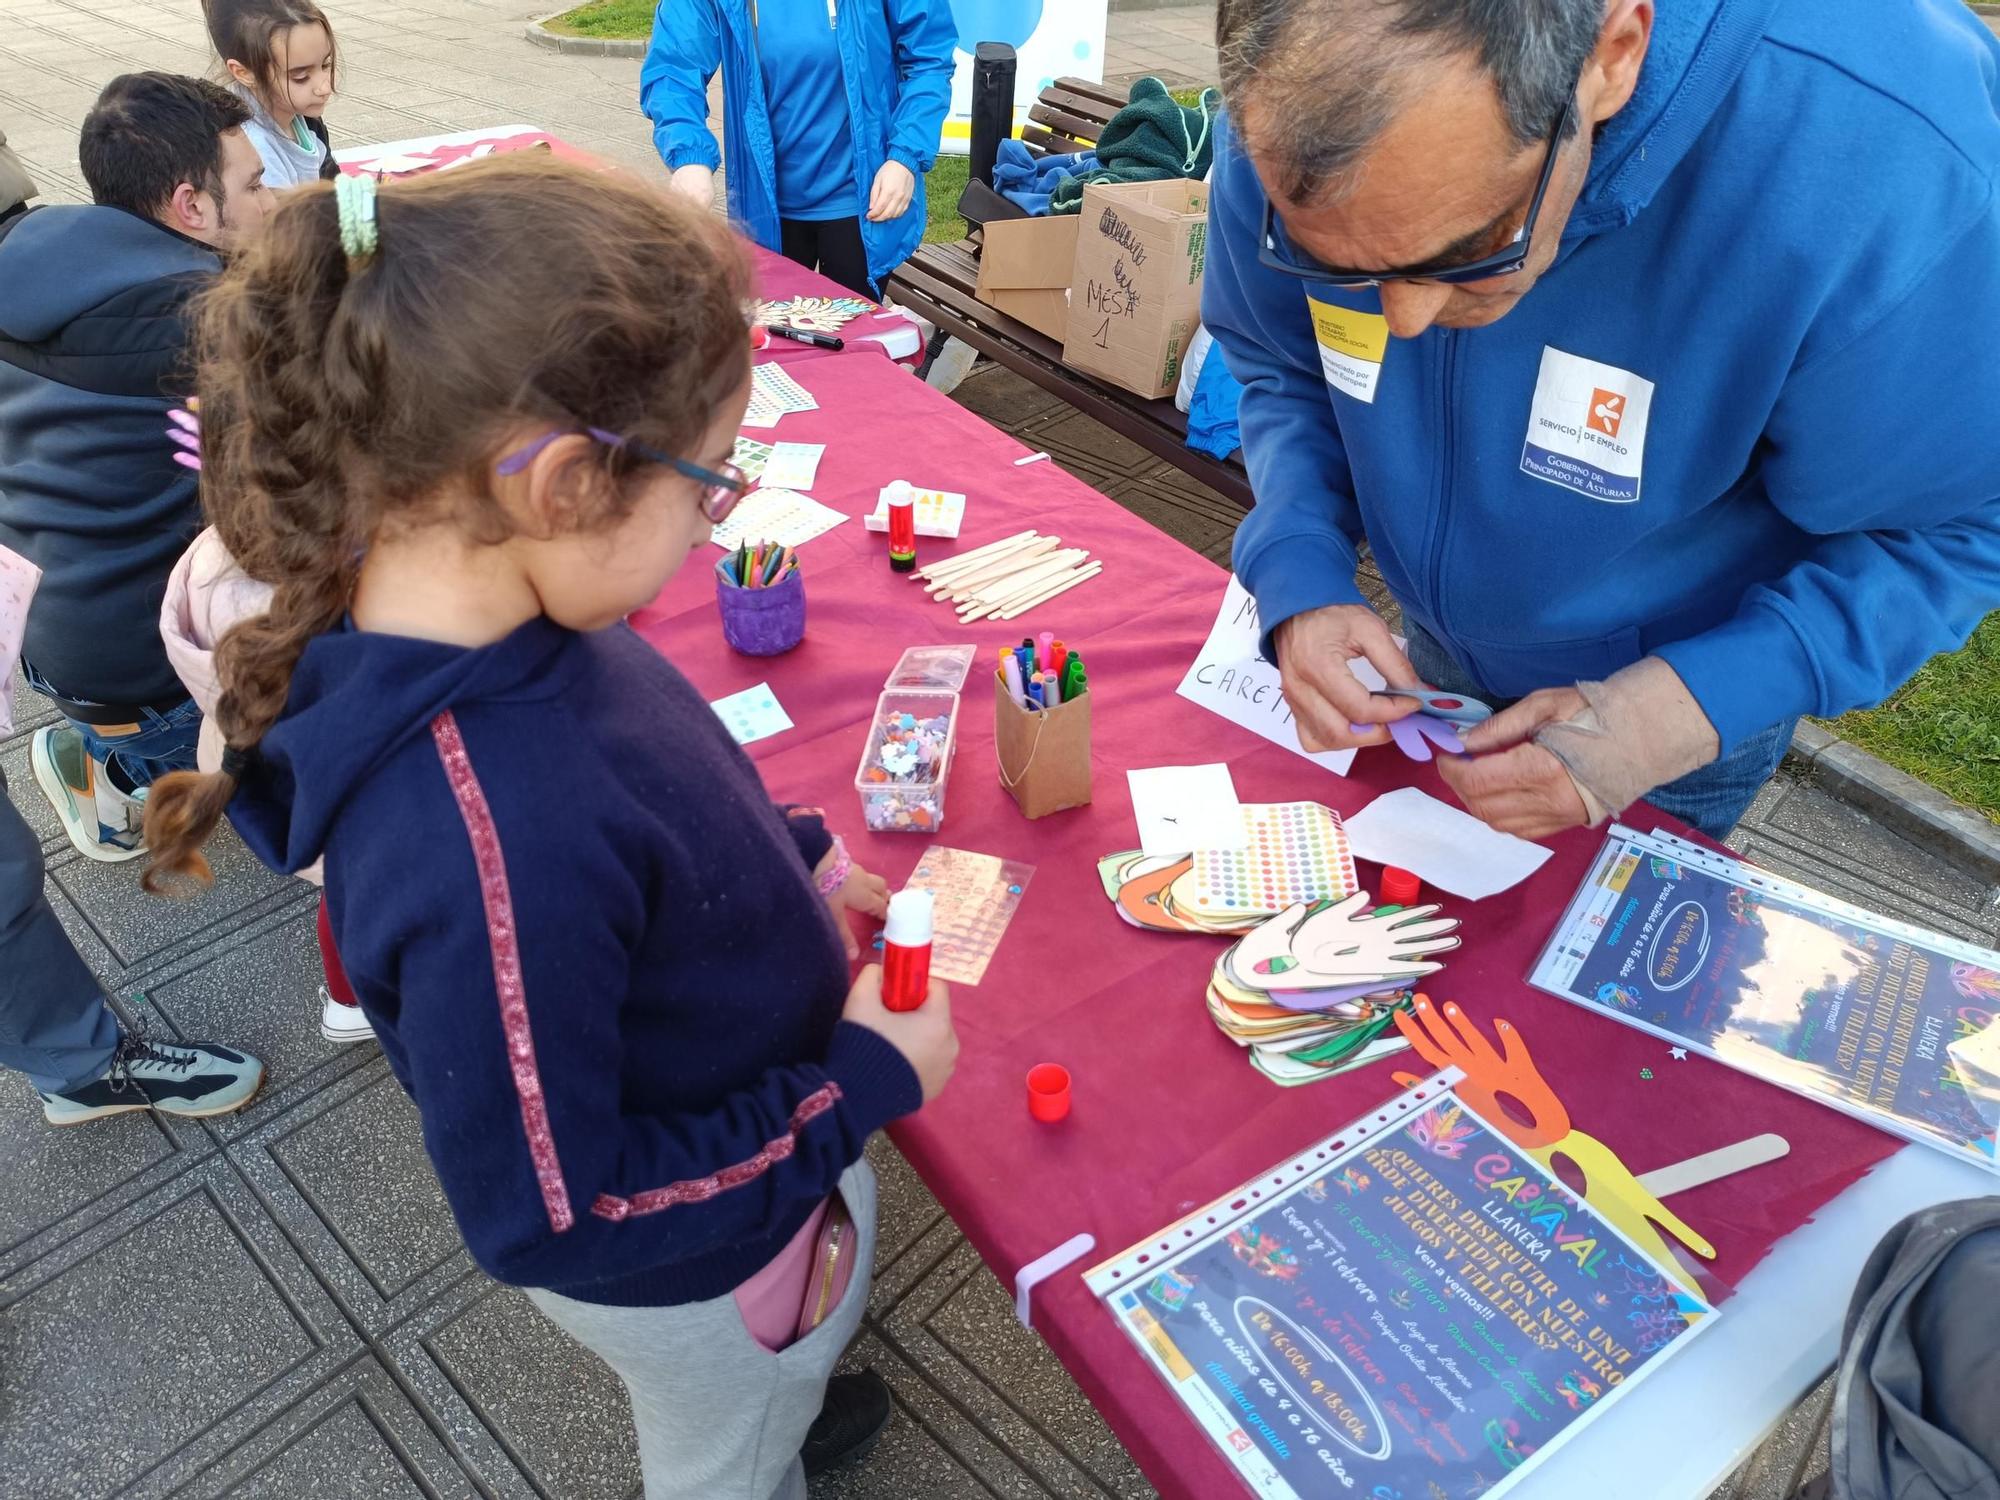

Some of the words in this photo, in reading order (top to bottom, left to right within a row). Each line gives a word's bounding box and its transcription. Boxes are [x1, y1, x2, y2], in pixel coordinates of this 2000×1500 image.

[1091, 317, 1109, 350] 1
[1339, 372, 1367, 388] Europea
[1356, 371, 1369, 380] por
[1540, 416, 1577, 437] SERVICIO
[1583, 431, 1596, 442] DE
[1596, 435, 1628, 456] EMPLEO
[1524, 457, 1572, 483] PRINCIPADO
[1573, 476, 1584, 488] DE
[1585, 480, 1632, 500] ASTURIAS
[1547, 454, 1590, 479] GOBIERNO
[1591, 472, 1604, 485] DEL
[1646, 899, 1664, 923] niños
[1657, 880, 1676, 902] Para
[1629, 946, 1642, 958] 16
[1634, 939, 1644, 947] a
[1641, 921, 1654, 933] de
[1618, 956, 1636, 978] años
[1903, 949, 1930, 1001] ¿QUIERES
[1870, 971, 1902, 1032] DIVERTIDA
[1836, 1006, 1868, 1071] TALLERES?
[1862, 1031, 1884, 1053] CON
[1884, 1002, 1918, 1067] DISFRUTAR
[1914, 1014, 1944, 1061] LLANERA
[1878, 1066, 1901, 1087] DE
[1474, 1154, 1605, 1277] CARNAVAL
[1481, 1199, 1552, 1262] LLANERA
[1305, 1237, 1325, 1251] y
[1323, 1246, 1337, 1258] 7
[1331, 1255, 1378, 1302] Febrero
[1379, 1148, 1462, 1210] ¿QUIERES
[1457, 1209, 1558, 1298] DISFRUTAR
[1556, 1297, 1589, 1326] DE
[1587, 1325, 1631, 1364] UNA
[1382, 1195, 1446, 1248] JUEGOS
[1443, 1245, 1461, 1260] Y
[1459, 1262, 1558, 1349] TALLERES?
[1401, 1265, 1448, 1313] Febrero
[1407, 1189, 1501, 1272] DIVERTIDA
[1499, 1271, 1539, 1307] CON
[1536, 1307, 1624, 1386] NUESTRO
[1413, 1243, 1437, 1269] Ven
[1433, 1266, 1445, 1277] a
[1444, 1274, 1496, 1321] vernos!!!
[1250, 1310, 1272, 1331] De
[1269, 1330, 1312, 1378] 16:00h.
[1322, 1391, 1367, 1442] 18:00h.
[1339, 1333, 1387, 1385] Febrero
[1400, 1319, 1426, 1343] Lugo
[1423, 1342, 1439, 1354] de
[1435, 1355, 1473, 1389] Llanera
[1191, 1300, 1225, 1337] Para
[1221, 1336, 1260, 1376] niños
[1257, 1377, 1277, 1397] de
[1277, 1397, 1291, 1410] 4
[1287, 1412, 1301, 1426] a
[1299, 1426, 1321, 1445] 16
[1316, 1448, 1354, 1488] años
[1204, 1359, 1254, 1415] Actividad
[1245, 1411, 1290, 1459] gratuita
